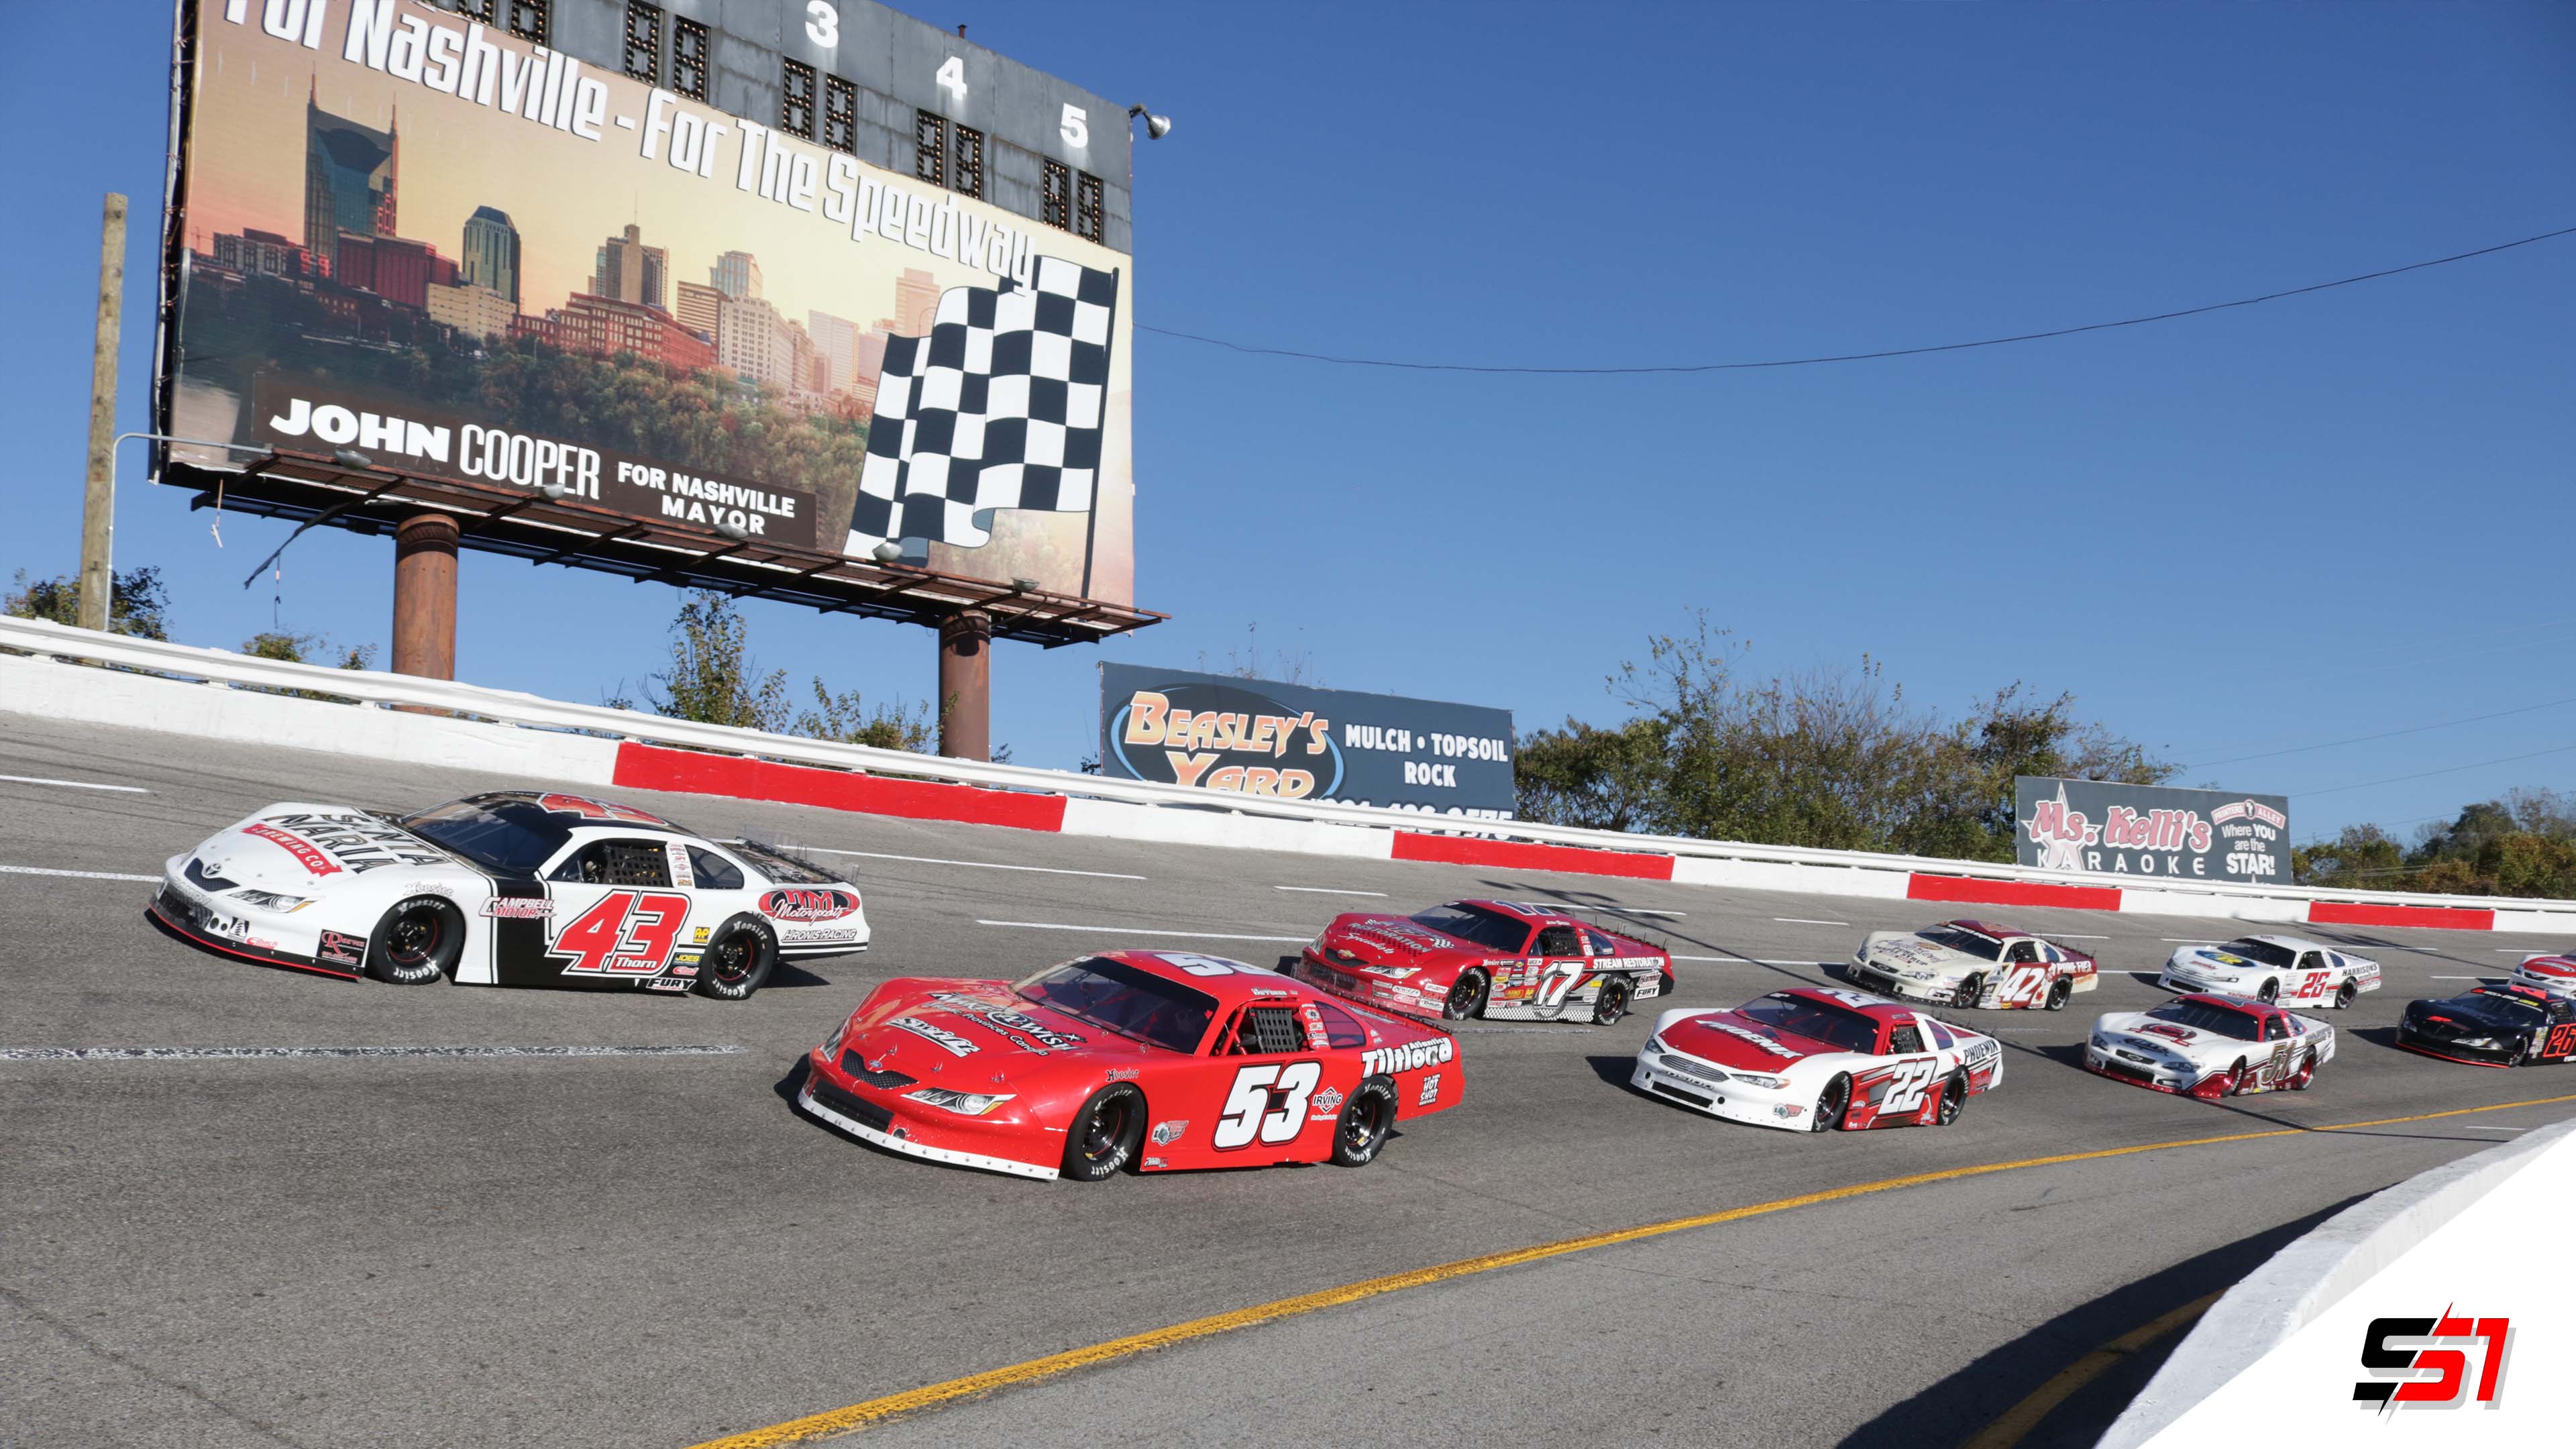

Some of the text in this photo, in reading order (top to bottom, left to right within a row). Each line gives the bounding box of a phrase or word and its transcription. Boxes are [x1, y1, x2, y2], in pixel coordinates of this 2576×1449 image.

[805, 0, 839, 48] 3
[936, 56, 968, 101] 4
[1059, 103, 1089, 150] 5
[343, 0, 608, 142] Nashville
[640, 87, 728, 179] For
[736, 118, 818, 213] The
[823, 152, 1036, 297] Speedway
[270, 398, 601, 500] JOHN COOPER
[618, 462, 796, 519] FOR NASHVILLE
[661, 494, 766, 535] MAYOR
[1124, 691, 1329, 759] BEASLEY'S
[1345, 723, 1509, 762] MULCH TOPSOIL
[1165, 751, 1316, 799] YARD
[1404, 761, 1457, 788] ROCK
[2029, 800, 2213, 853] Ms. Kelli's
[2257, 807, 2281, 824] ALLEY
[2221, 823, 2276, 841] Where YOU
[2234, 838, 2265, 852] are the
[2037, 849, 2205, 875] KARAOKE
[2226, 852, 2275, 875] STAR!
[545, 889, 692, 977] 43
[615, 957, 658, 969] Thorn
[1593, 958, 1623, 969] STREAM
[647, 979, 696, 990] FURY
[1534, 961, 1586, 1008] 17
[1636, 987, 1658, 998] FURY
[1998, 967, 2045, 1002] 42
[1009, 1034, 1050, 1057] Canada
[1963, 1039, 1998, 1063] PHOENIX
[1106, 1067, 1139, 1082] Hoosier
[1423, 1079, 1439, 1091] HOT
[1878, 1058, 1938, 1116] 22
[1214, 1061, 1322, 1148] 53
[1313, 1093, 1343, 1106] IRVING
[1420, 1088, 1438, 1102] SHOT
